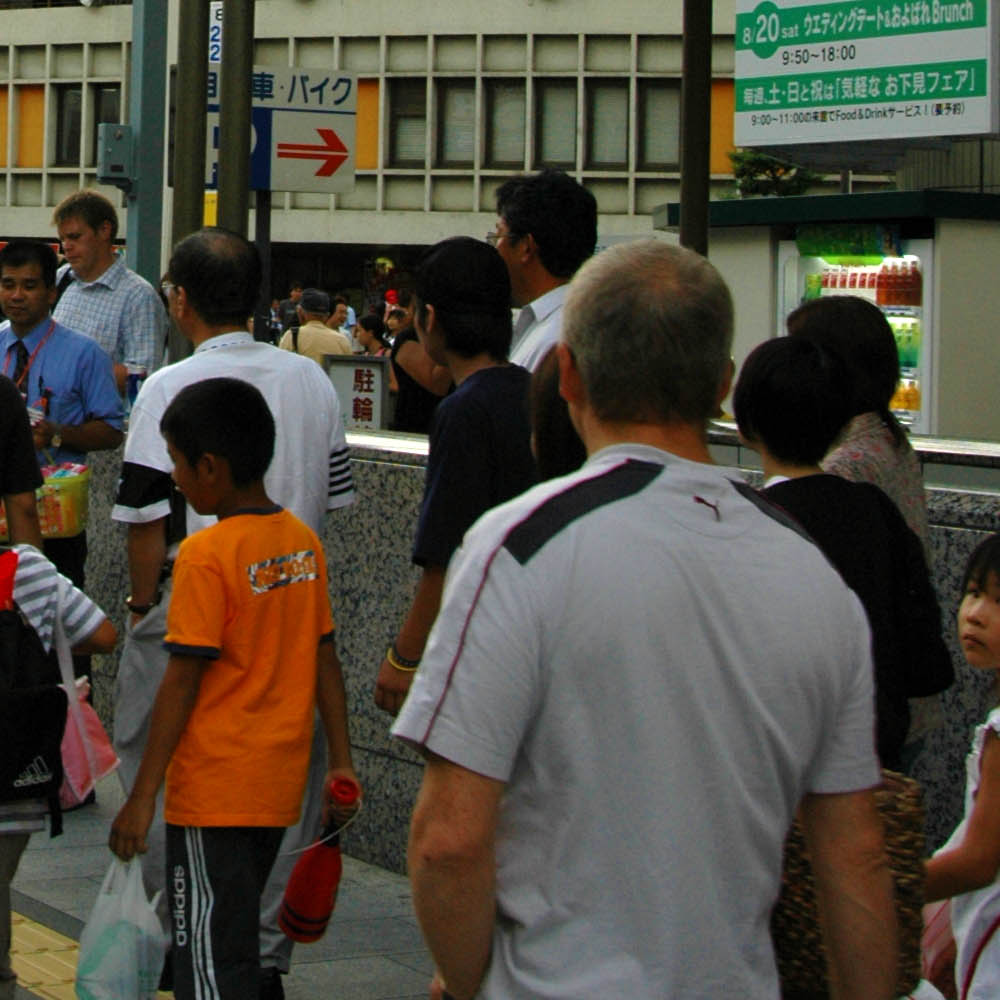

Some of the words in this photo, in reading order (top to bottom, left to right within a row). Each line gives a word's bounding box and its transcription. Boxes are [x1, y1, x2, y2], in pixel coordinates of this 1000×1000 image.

[743, 13, 780, 45] 8/20
[782, 24, 799, 38] sat
[352, 368, 375, 429] 駐輪
[173, 864, 188, 947] adidas
